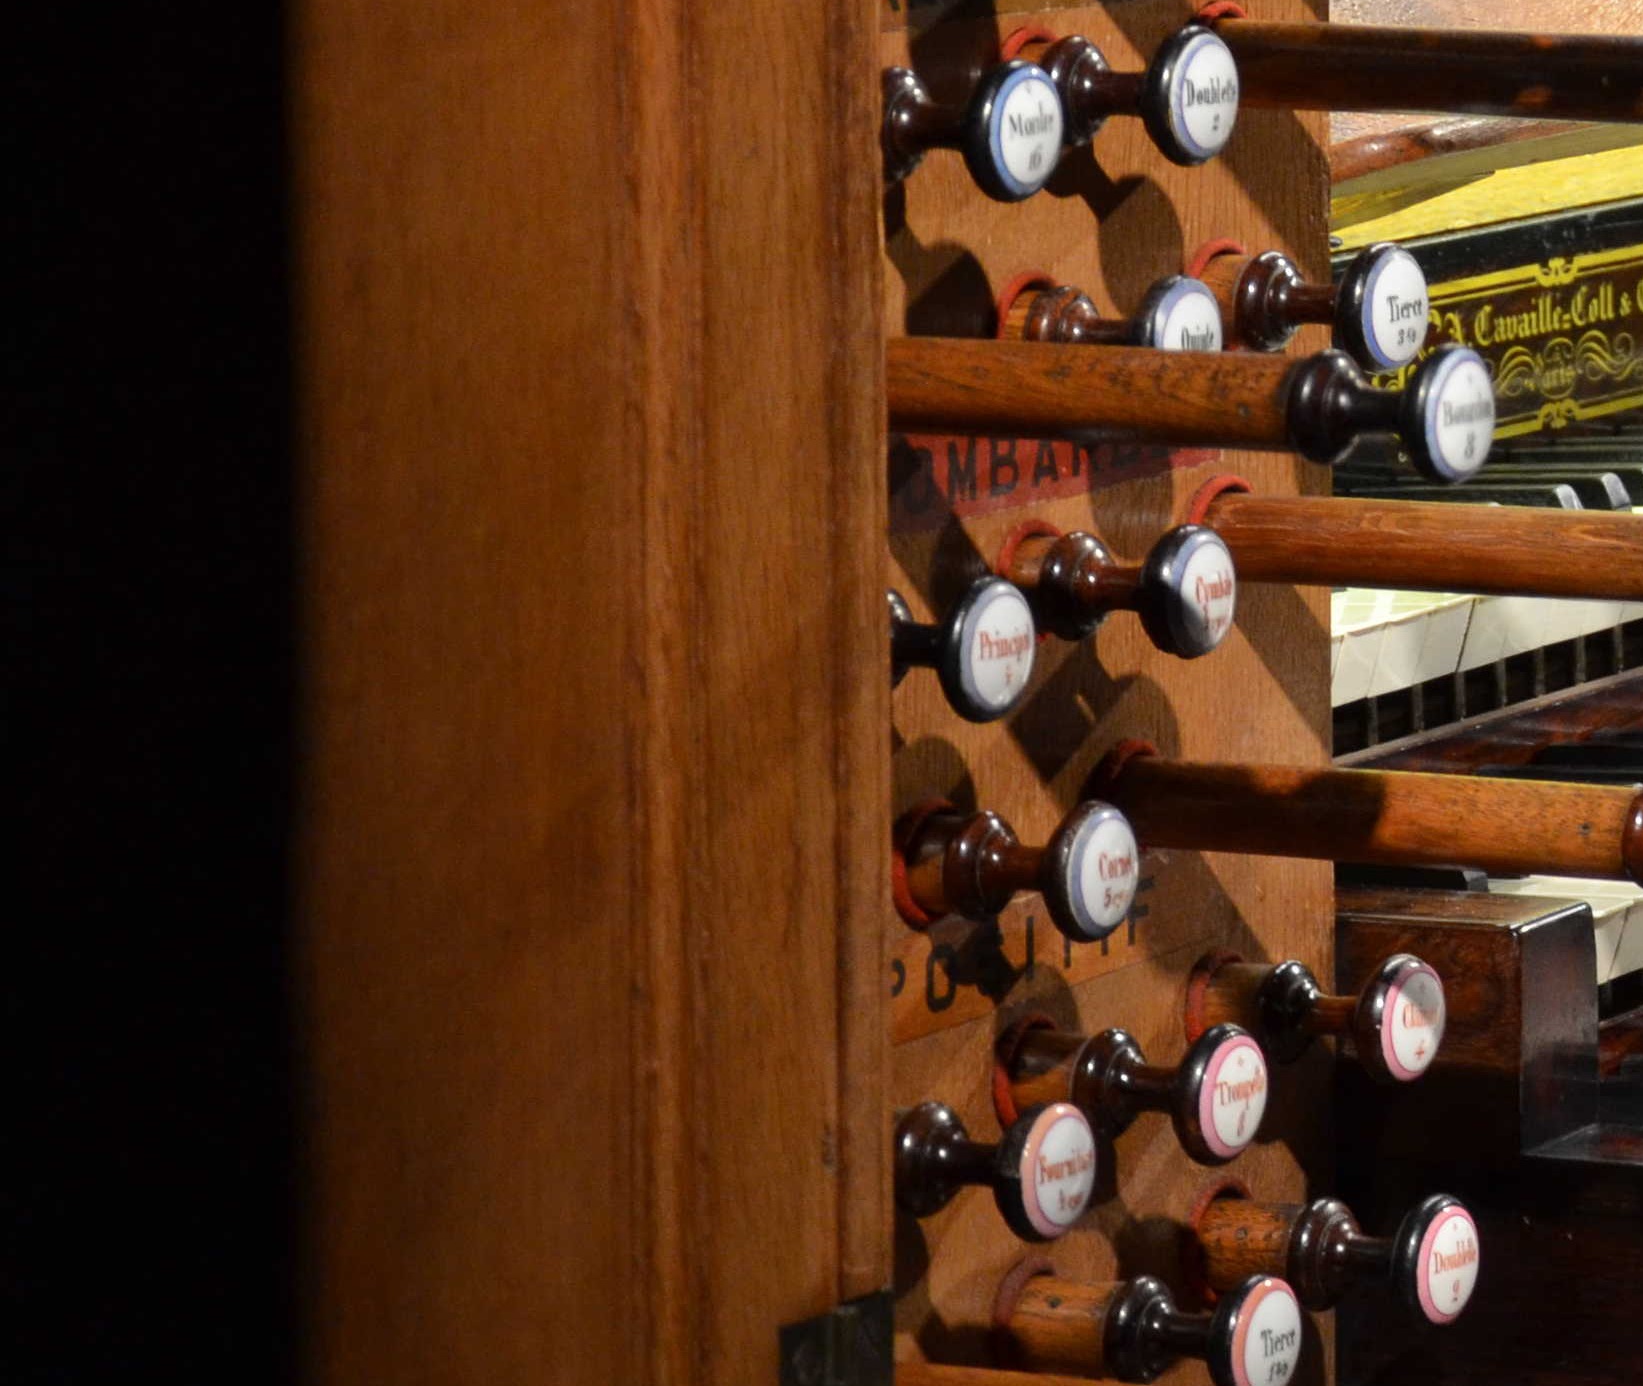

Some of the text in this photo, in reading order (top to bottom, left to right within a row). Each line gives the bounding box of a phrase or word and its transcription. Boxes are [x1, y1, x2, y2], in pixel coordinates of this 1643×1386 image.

[1028, 147, 1043, 172] 16
[1386, 294, 1424, 324] Tierce
[1620, 290, 1632, 316] &
[1261, 1329, 1298, 1358] Tierce
